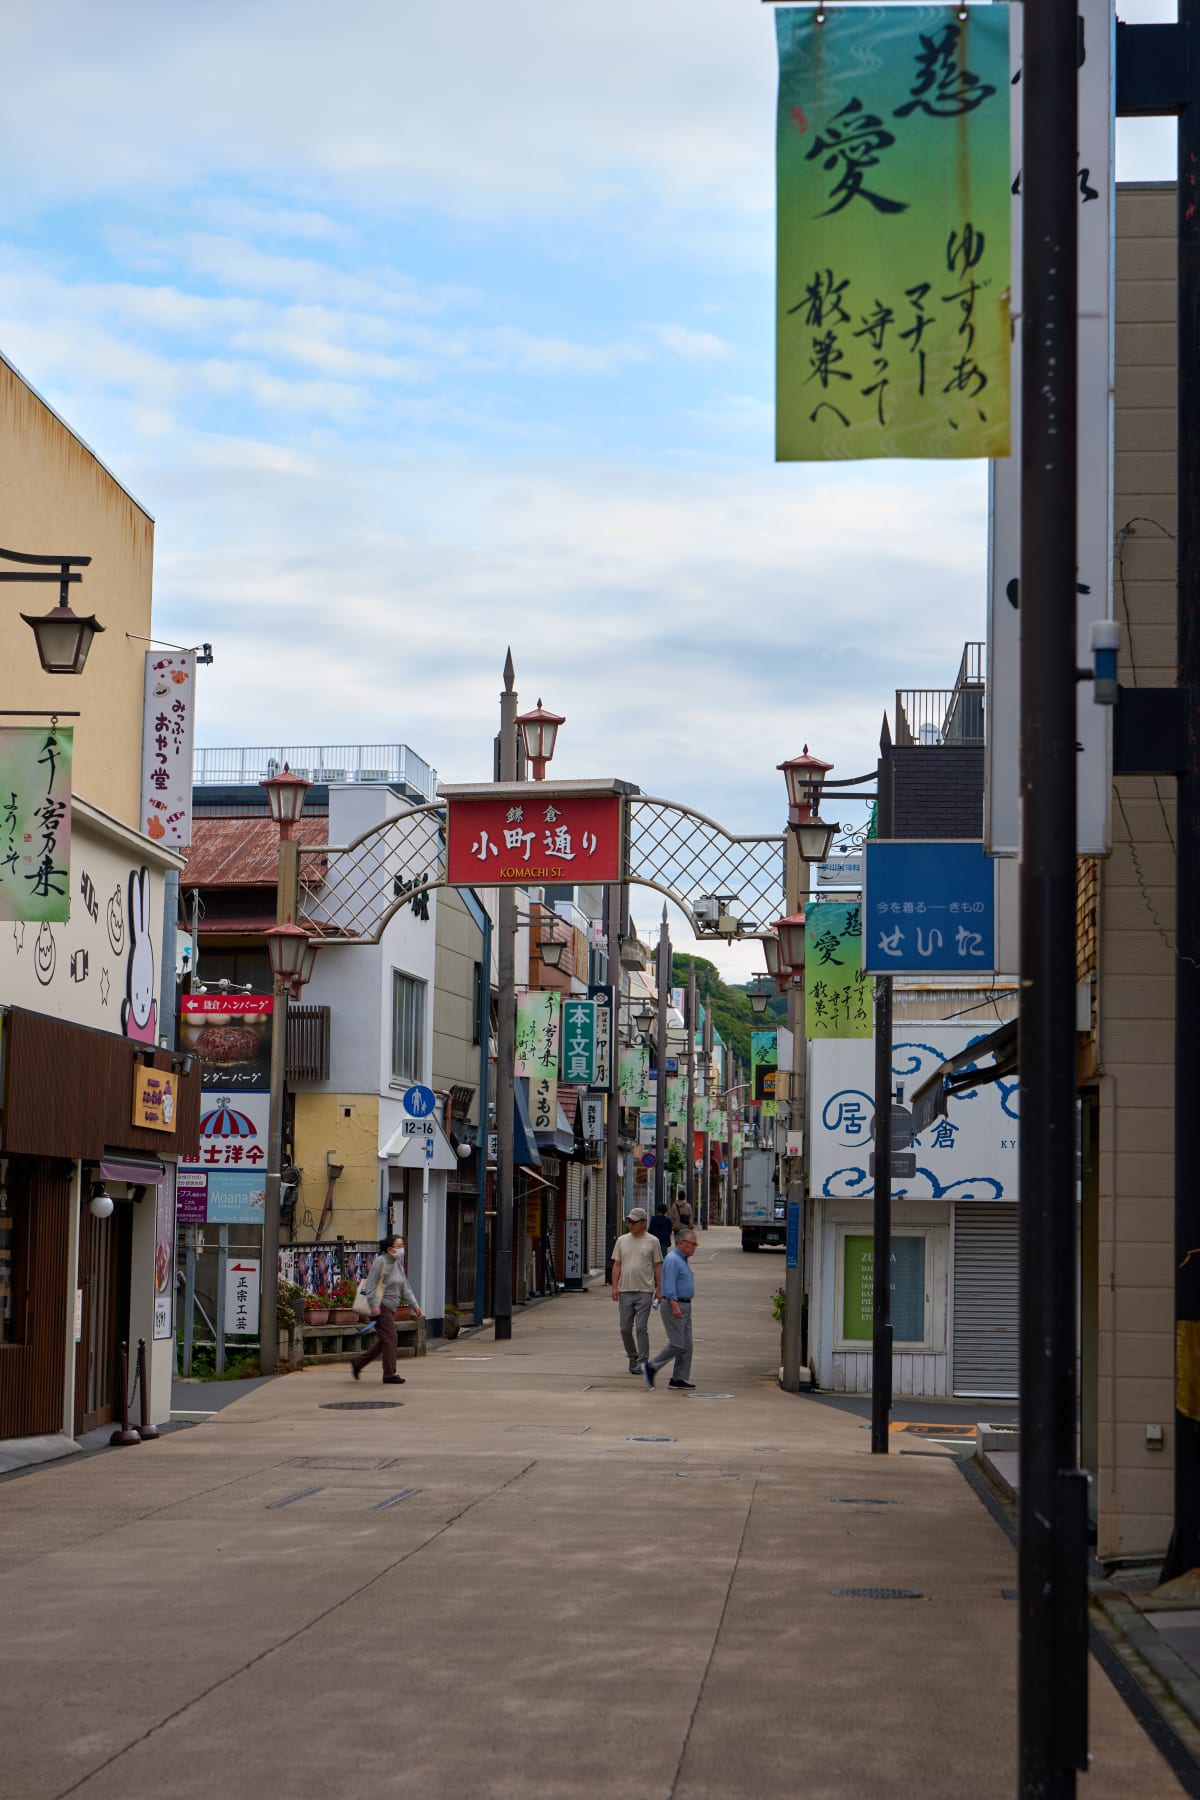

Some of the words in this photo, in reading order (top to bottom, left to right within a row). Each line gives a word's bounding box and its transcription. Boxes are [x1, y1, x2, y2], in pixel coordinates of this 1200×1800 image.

[787, 268, 853, 427] 散策へ
[900, 282, 936, 397] マナー
[942, 222, 994, 430] ゆずりあい
[852, 299, 896, 426] 守って
[150, 711, 171, 791] おやつ堂
[24, 736, 69, 897] 千客万来
[505, 804, 563, 823] 鎌倉
[470, 825, 598, 861] 小町通り
[500, 867, 549, 878] KOMACHI
[405, 1122, 434, 1134] 12-16
[536, 1078, 551, 1128] きもの
[210, 1192, 248, 1204] Moana
[236, 1276, 248, 1331] 正宗工芸
